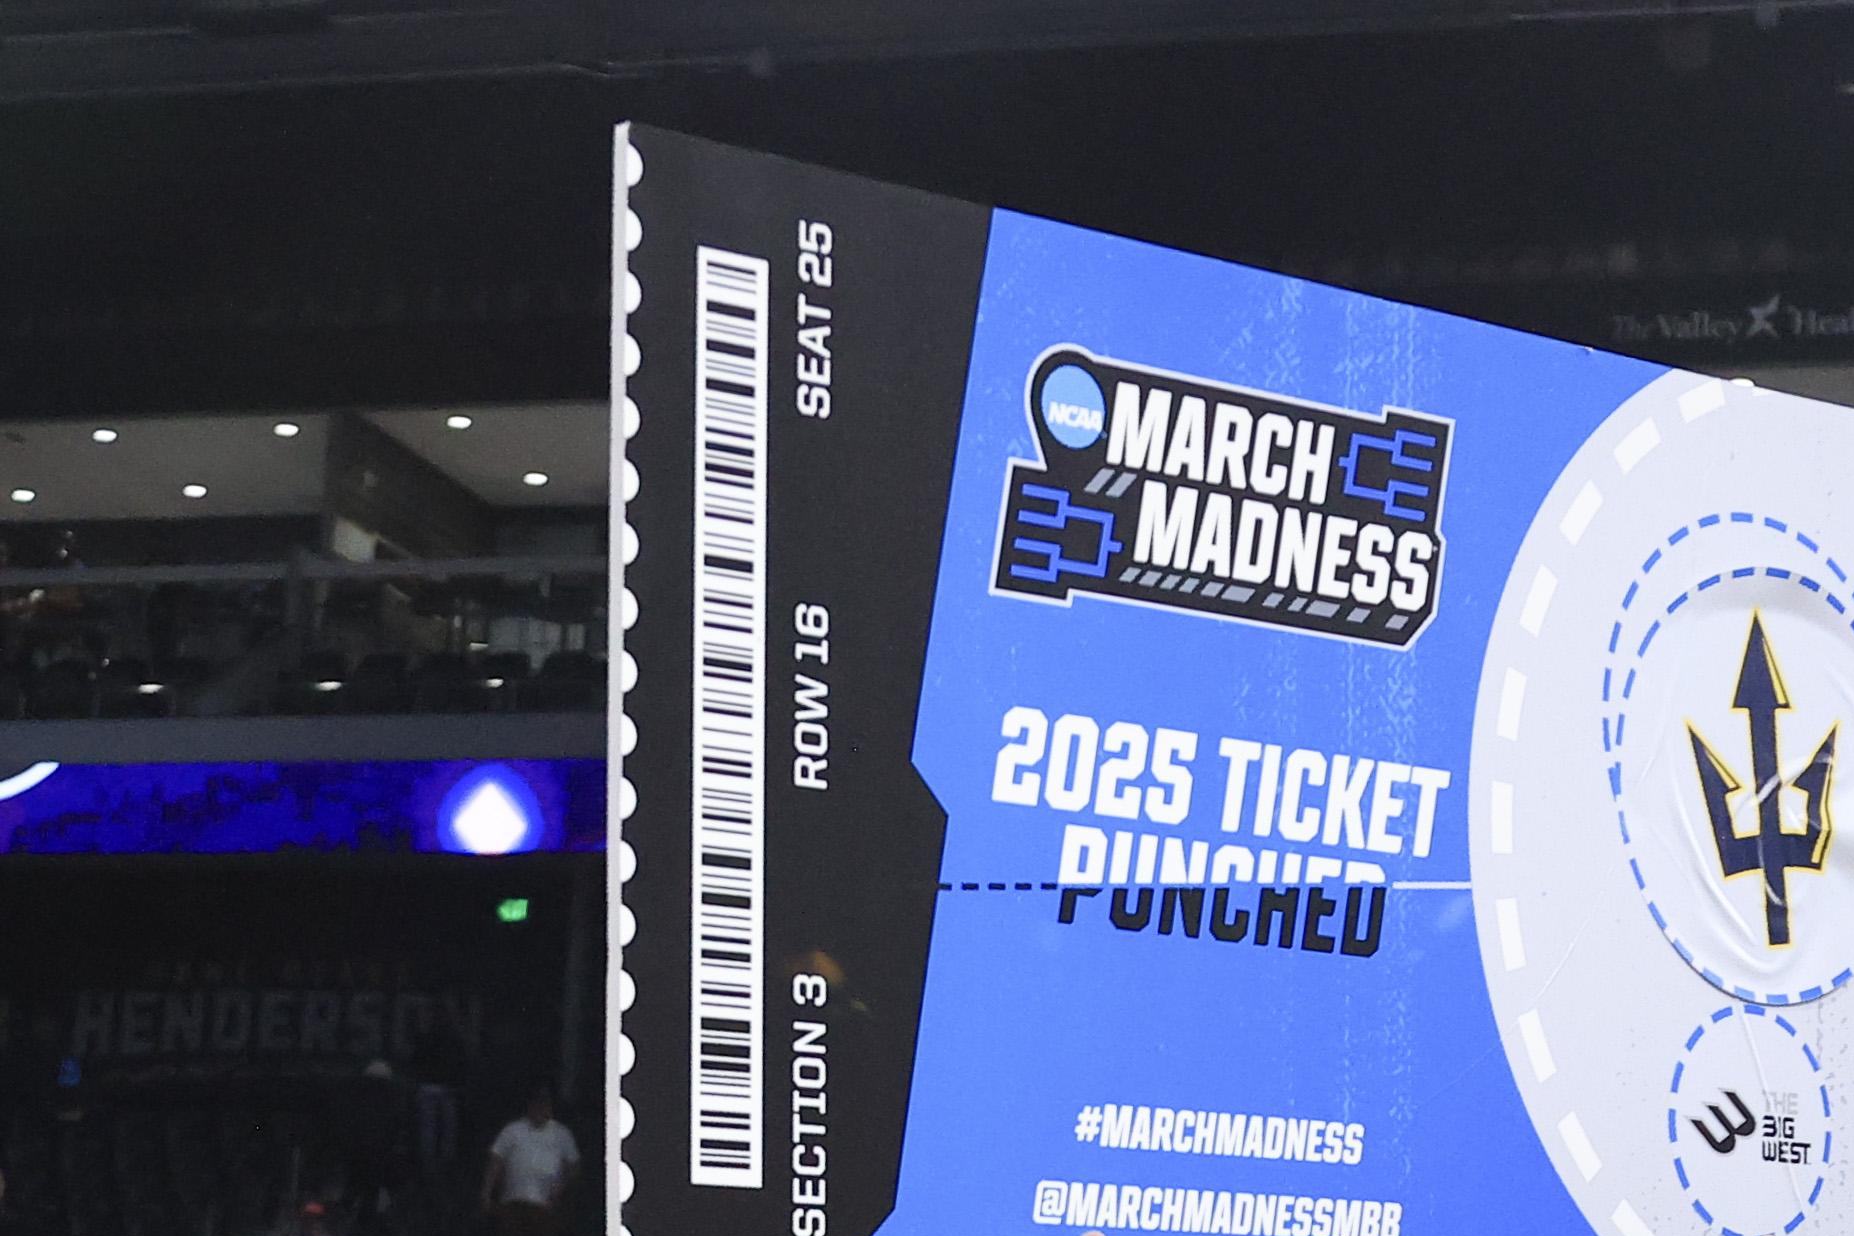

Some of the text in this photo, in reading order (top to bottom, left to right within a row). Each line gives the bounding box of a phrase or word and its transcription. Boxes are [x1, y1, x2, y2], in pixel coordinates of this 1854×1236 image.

[797, 219, 833, 420] SEAT 25
[1654, 309, 1744, 345] Valley
[1047, 400, 1104, 432] NCAA
[1105, 380, 1336, 504] MARCH
[1132, 481, 1436, 613] MADNESS
[793, 602, 831, 792] ROW 16
[991, 705, 1452, 859] 2025 TICKET
[1056, 823, 1388, 959] PUNCHED
[792, 972, 829, 1008] 3
[1761, 1088, 1800, 1116] THE
[1762, 1115, 1795, 1139] BIG
[1074, 1103, 1365, 1167] #MARCHMADNESS
[1761, 1140, 1812, 1165] WEST
